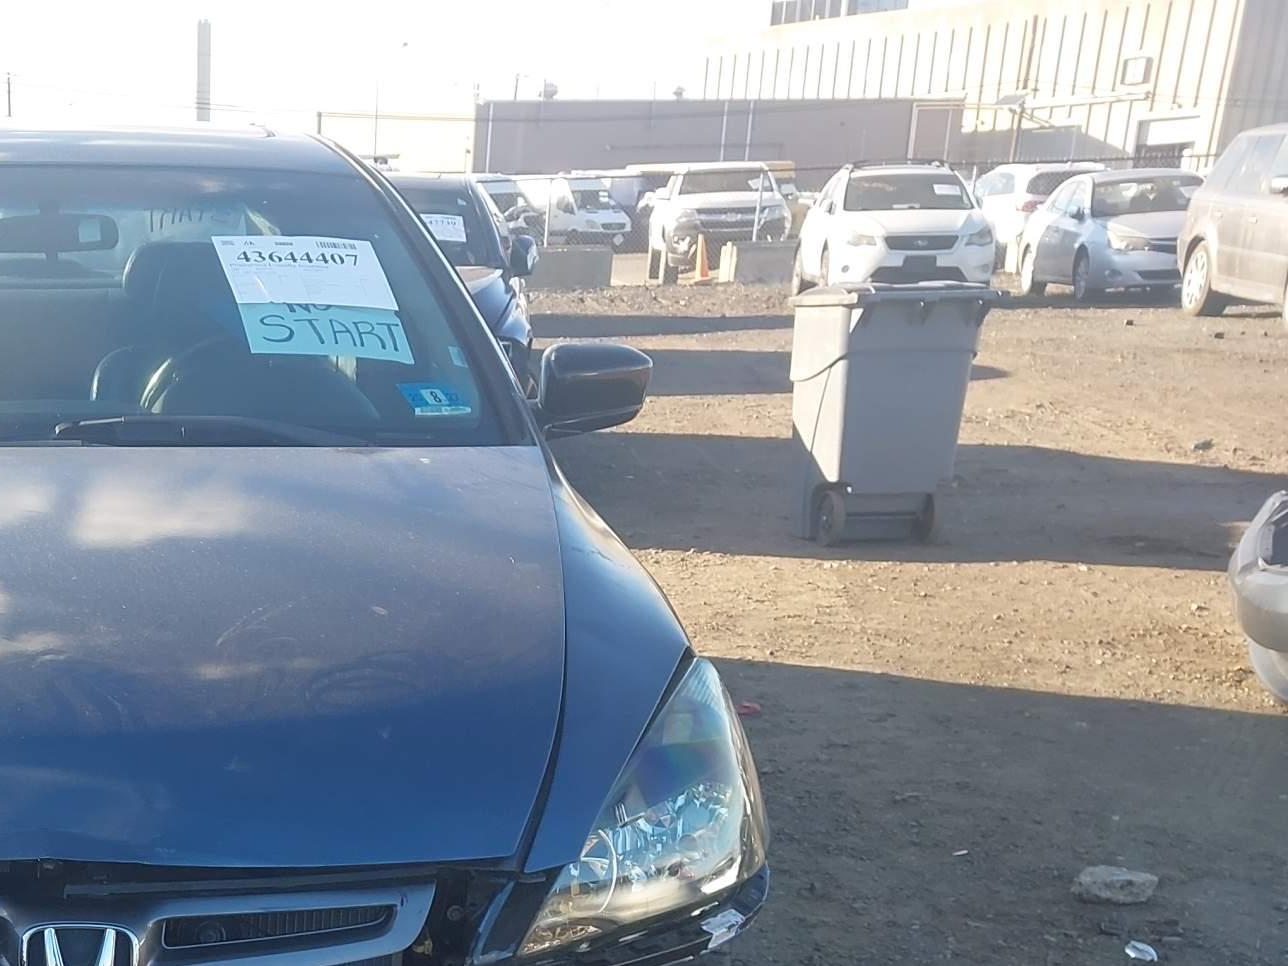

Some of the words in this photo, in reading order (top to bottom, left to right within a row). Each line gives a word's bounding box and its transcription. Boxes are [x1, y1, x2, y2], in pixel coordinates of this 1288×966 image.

[236, 249, 359, 267] 43644407
[259, 314, 400, 353] START
[429, 390, 443, 404] 8
